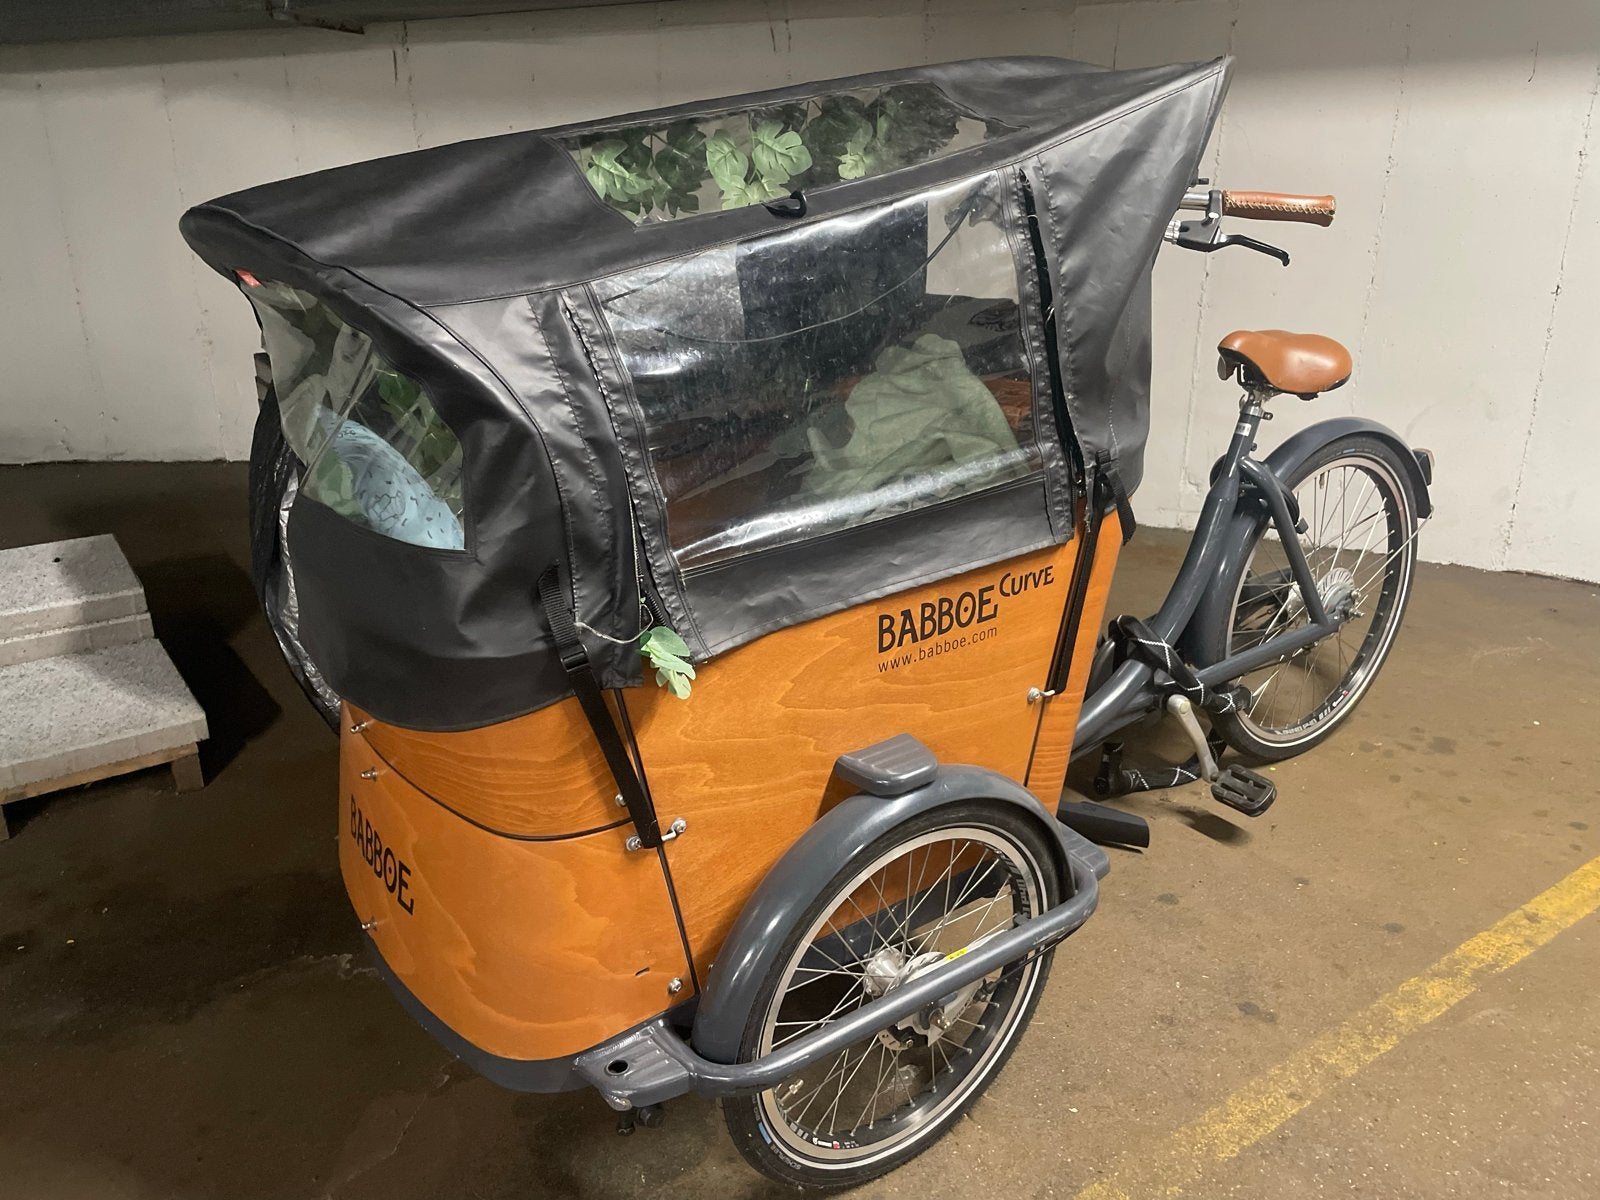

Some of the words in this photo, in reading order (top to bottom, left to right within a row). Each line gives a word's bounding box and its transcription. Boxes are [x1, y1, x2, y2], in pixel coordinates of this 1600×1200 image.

[878, 585, 998, 654] BABBOE
[878, 625, 998, 673] www.babboe.com
[351, 794, 414, 916] BABBOE
